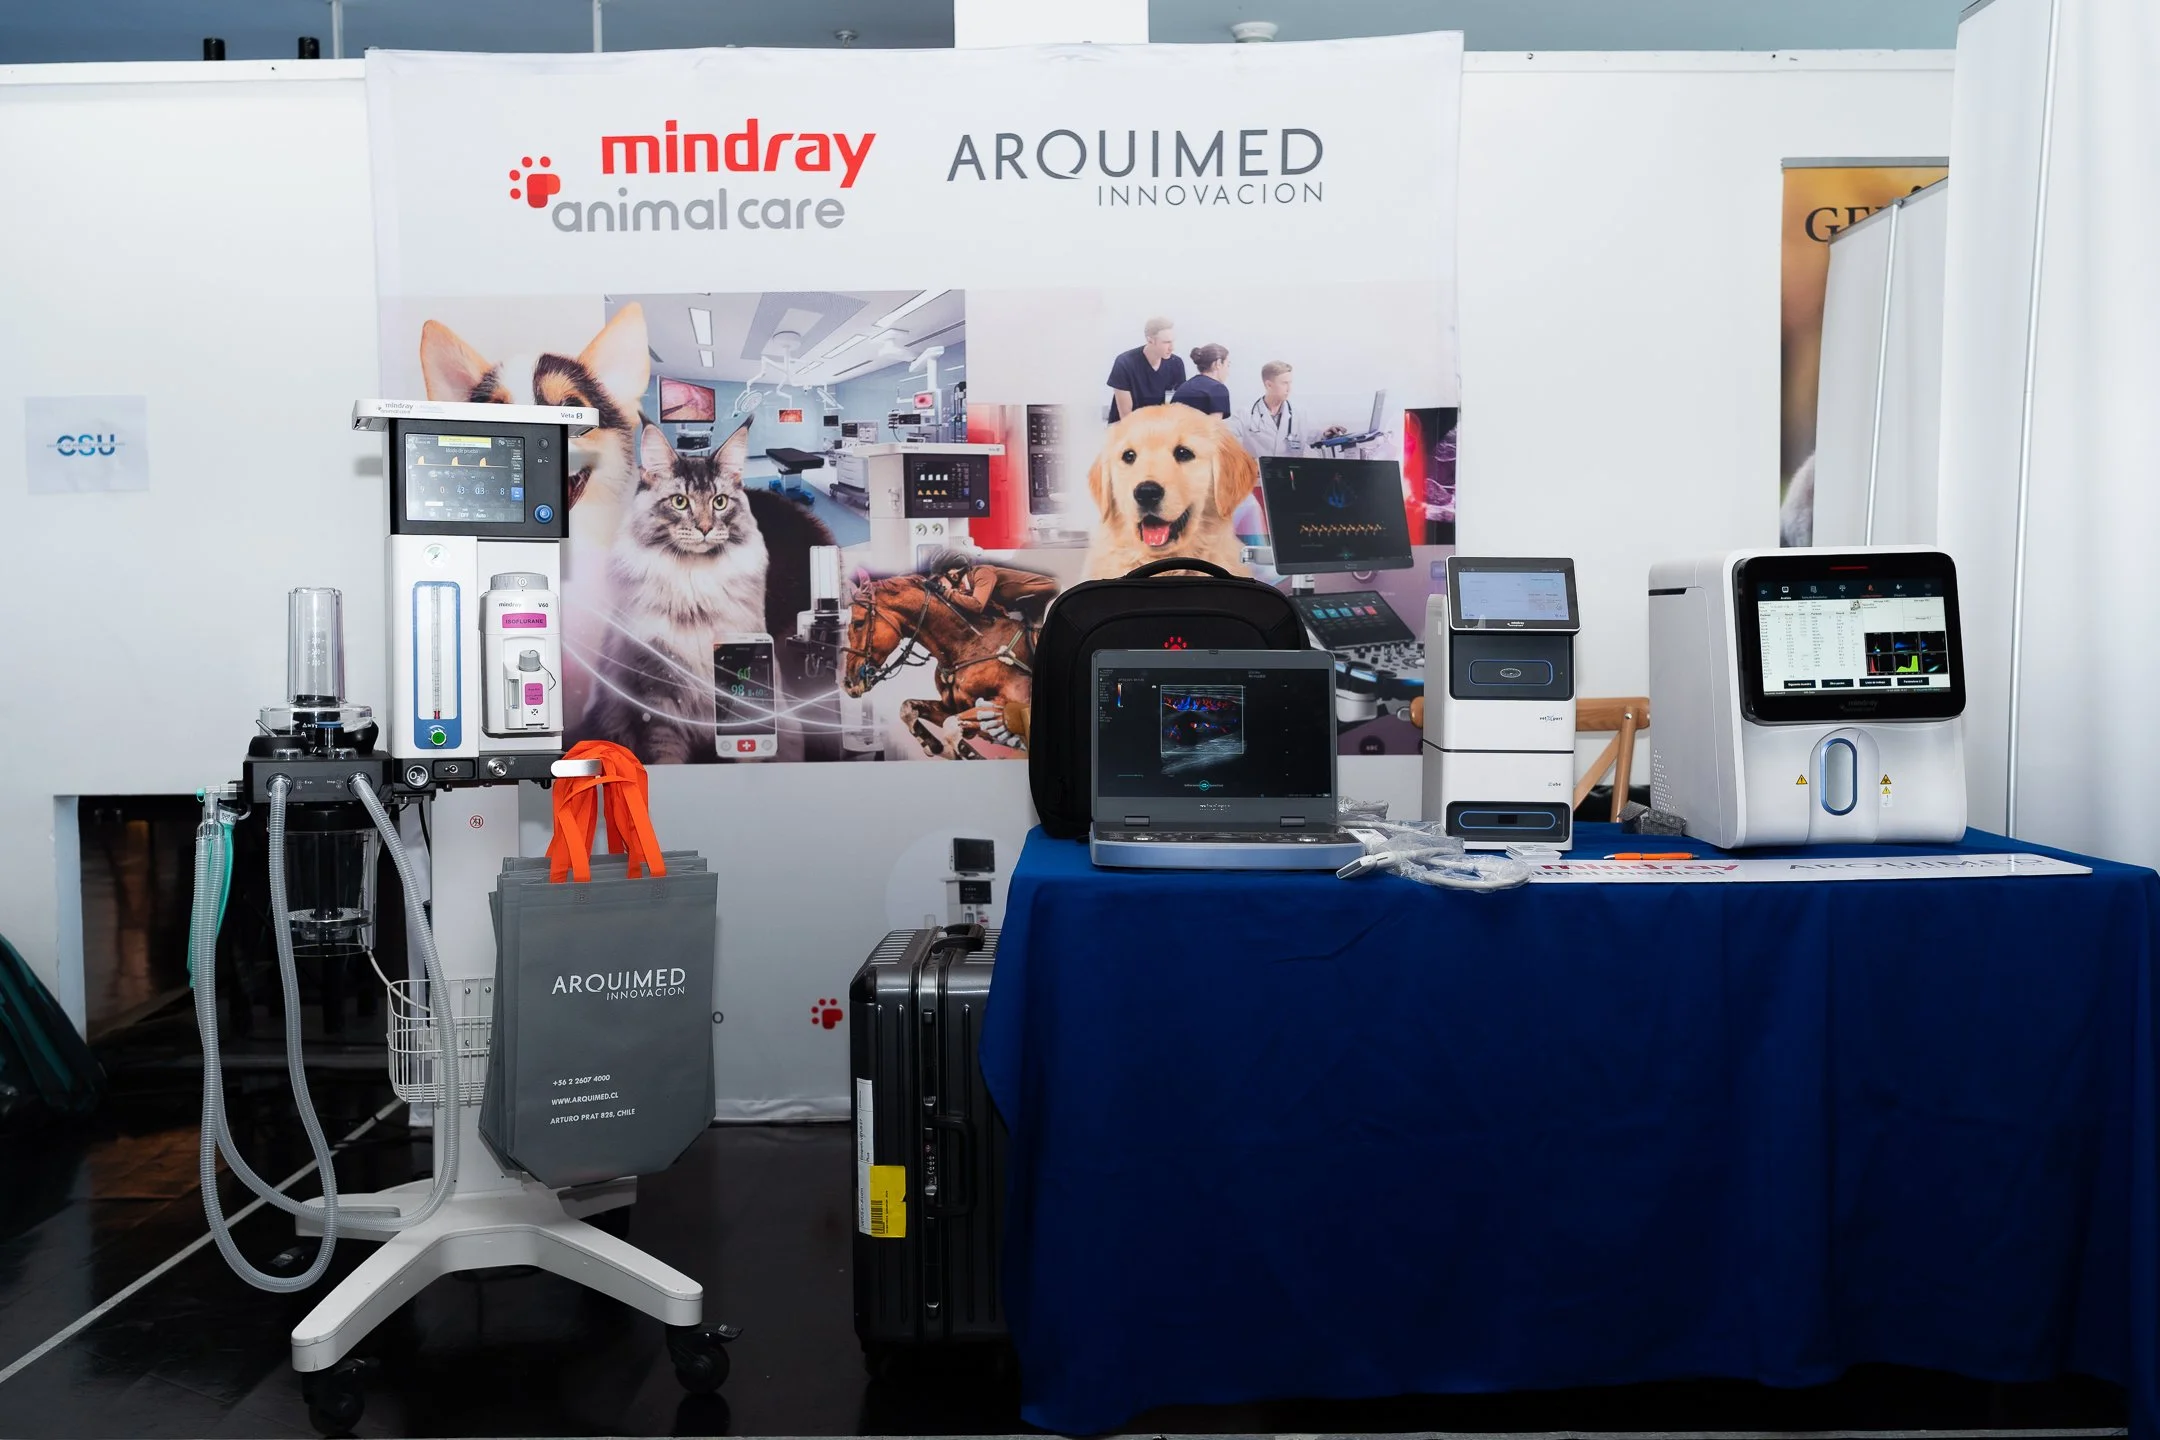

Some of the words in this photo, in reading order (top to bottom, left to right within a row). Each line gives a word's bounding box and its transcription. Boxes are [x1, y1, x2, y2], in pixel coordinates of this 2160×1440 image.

[601, 118, 876, 188] mindray
[947, 128, 1324, 182] ARQUIMED
[1098, 181, 1323, 206] INNOVACION
[551, 188, 726, 233] animal
[737, 197, 845, 231] care
[56, 433, 116, 457] CSU
[1541, 863, 1740, 871] mindray
[551, 967, 687, 995] ARQUIMED
[606, 986, 685, 1001] INNOVACION
[552, 1079, 567, 1087] +56
[574, 1076, 592, 1084] 2607
[593, 1074, 611, 1082] 4000
[551, 1091, 619, 1106] WWW.ARQUIMED.CL
[550, 1114, 580, 1125] ARTURO
[581, 1112, 599, 1121] PRAT
[616, 1108, 636, 1117] CHILE
